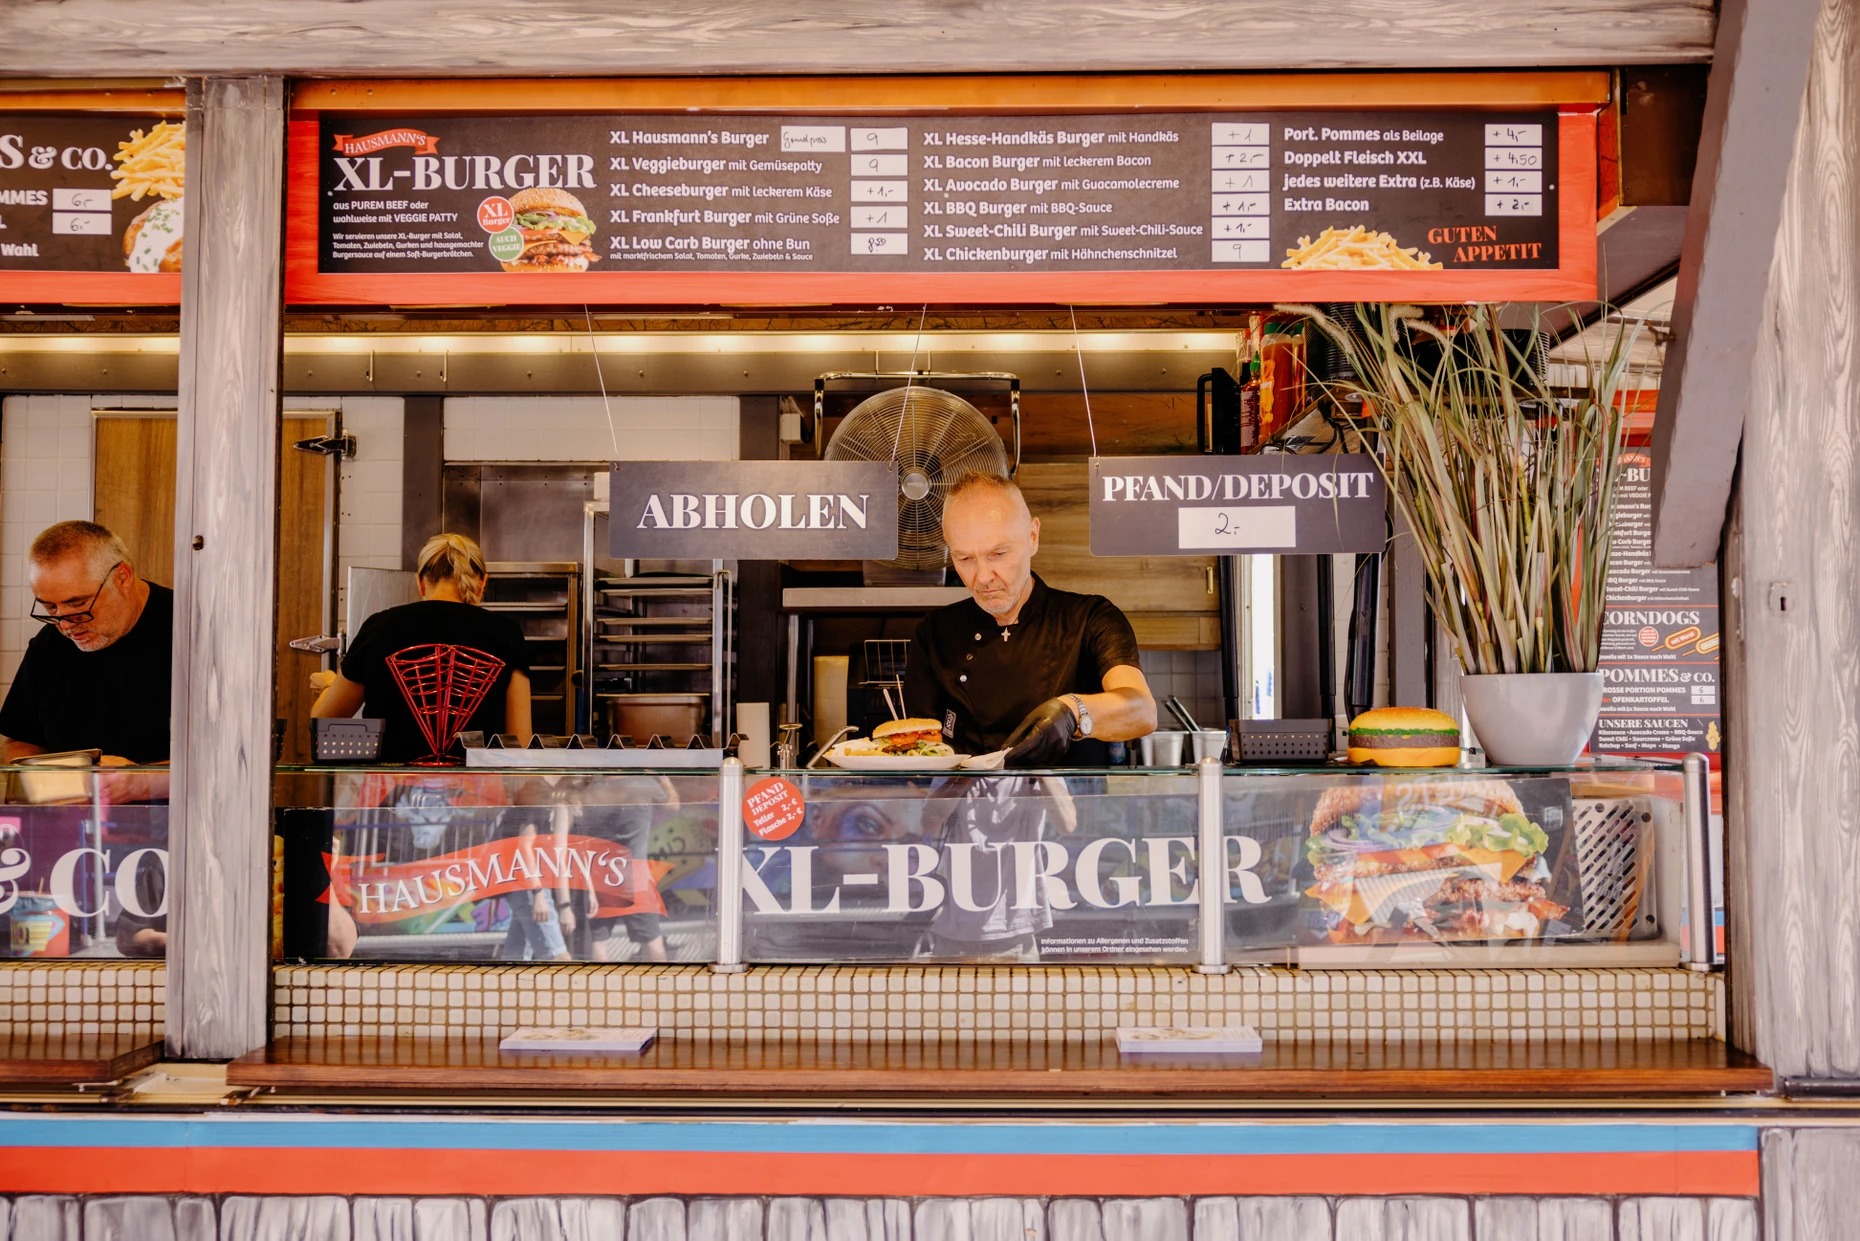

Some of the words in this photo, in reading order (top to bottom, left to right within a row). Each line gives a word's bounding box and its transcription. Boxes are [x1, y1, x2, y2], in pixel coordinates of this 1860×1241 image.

[344, 132, 427, 154] HAUSMANN'S
[610, 131, 629, 143] XL
[633, 130, 718, 144] Hausmann's
[722, 131, 769, 148] Burger
[866, 132, 879, 146] 9
[924, 133, 942, 145] XL
[946, 131, 1054, 145] Hesse-Handkäs
[1057, 131, 1105, 147] Burger
[1108, 132, 1126, 142] mit
[1130, 131, 1178, 142] Handkäs
[1284, 127, 1318, 140] Port.
[1322, 128, 1380, 140] Pommes
[1383, 130, 1400, 141] als
[1403, 130, 1443, 144] Beilage
[28, 146, 57, 170] &
[61, 147, 113, 170] CO.
[610, 158, 629, 169] XL
[632, 157, 726, 174] Veggieburger
[729, 160, 747, 170] mit
[750, 160, 822, 173] Gemüsepatty
[868, 158, 879, 173] 9
[924, 156, 943, 168] XL
[946, 156, 989, 168] Bacon
[993, 155, 1040, 171] Burger
[1043, 156, 1061, 167] mit
[1064, 156, 1113, 166] leckerem
[1117, 156, 1151, 165] Bacon
[1285, 151, 1341, 167] Doppelt
[1344, 150, 1393, 164] Fleisch
[1397, 151, 1426, 164] XXL
[333, 154, 597, 191] XL-BURGER
[924, 180, 943, 191] XL
[946, 179, 1007, 192] Avocado
[1011, 178, 1058, 194] Burger
[1062, 179, 1079, 189] mit
[1082, 178, 1179, 189] Guacamolecreme
[1282, 173, 1321, 191] jedes
[1324, 174, 1376, 187] weitere
[1379, 174, 1416, 187] Extra
[1420, 177, 1443, 189] (z.B.
[1446, 177, 1475, 189] Käse)
[610, 184, 629, 196] XL
[633, 184, 728, 200] Cheeseburger
[732, 186, 750, 196] mit
[753, 186, 803, 197] leckerem
[806, 187, 832, 197] Käse
[352, 201, 384, 209] PUREM
[386, 201, 408, 209] BEEF
[410, 201, 429, 209] oder
[483, 202, 508, 218] XL
[924, 202, 943, 214] XL
[947, 202, 977, 217] BBQ
[980, 202, 1027, 218] Burger
[1030, 203, 1048, 213] mit
[1051, 203, 1112, 214] BBQ-Sauce
[1285, 198, 1322, 211] Extra
[1326, 198, 1369, 211] Bacon
[379, 214, 392, 222] mit
[394, 214, 427, 222] VEGGIE
[429, 213, 458, 221] PATTY
[482, 217, 511, 227] Burger
[610, 210, 629, 222] XL
[633, 209, 701, 226] Frankfurt
[704, 211, 752, 227] Burger
[755, 213, 773, 223] mit
[776, 213, 809, 223] Grüne
[812, 213, 839, 226] Soße
[345, 232, 374, 240] servieren
[398, 232, 430, 242] XL-Burger
[432, 231, 442, 240] mit
[444, 231, 463, 240] Salat,
[924, 225, 943, 237] XL
[946, 223, 1026, 237] Sweet-Chili
[1030, 224, 1077, 240] Burger
[1081, 225, 1099, 236] mit
[1102, 224, 1202, 235] Sweet-Chili-Sauce
[1427, 226, 1497, 244] GUTEN
[492, 243, 521, 253] VEGGIE
[494, 235, 517, 245] AUCH
[610, 237, 629, 248] XL
[633, 237, 662, 249] Low
[666, 236, 698, 249] Carb
[702, 237, 750, 252] Burger
[753, 238, 783, 249] ohne
[786, 238, 809, 249] Bun
[0, 243, 40, 257] Wahl
[924, 248, 943, 260] XL
[946, 247, 1048, 264] Chickenburger
[1051, 249, 1068, 259] mit
[1072, 248, 1177, 259] Hähnchenschnitzel
[1453, 243, 1542, 263] APPETIT
[1102, 472, 1374, 502] PFAND/DEPOSIT
[637, 493, 870, 530] ABHOLEN
[1600, 668, 1680, 683] POMMES
[1693, 672, 1716, 683] CO.
[1603, 686, 1625, 694] ROSSE
[1625, 686, 1656, 694] PORTION
[1656, 686, 1687, 694] POMMES
[1599, 718, 1643, 729] UNSERE
[1643, 718, 1689, 729] SAUCEN
[747, 782, 784, 809] PFAND
[751, 790, 788, 816] DEPOSIT
[753, 811, 775, 828] Teller
[758, 817, 788, 837] Flasche
[357, 846, 629, 915] HAUSMANN'S
[715, 835, 1272, 916] XL-BURGER
[1041, 937, 1086, 945] Informationen
[1096, 937, 1130, 945] Allergenen
[1131, 937, 1144, 945] und
[1145, 937, 1188, 945] Zusatzstoffen
[1042, 945, 1065, 954] können
[1066, 945, 1072, 954] in
[1073, 945, 1101, 954] unserem
[1102, 945, 1124, 954] Ordner
[1125, 945, 1161, 955] eingesehen
[1163, 945, 1188, 955] werden.
